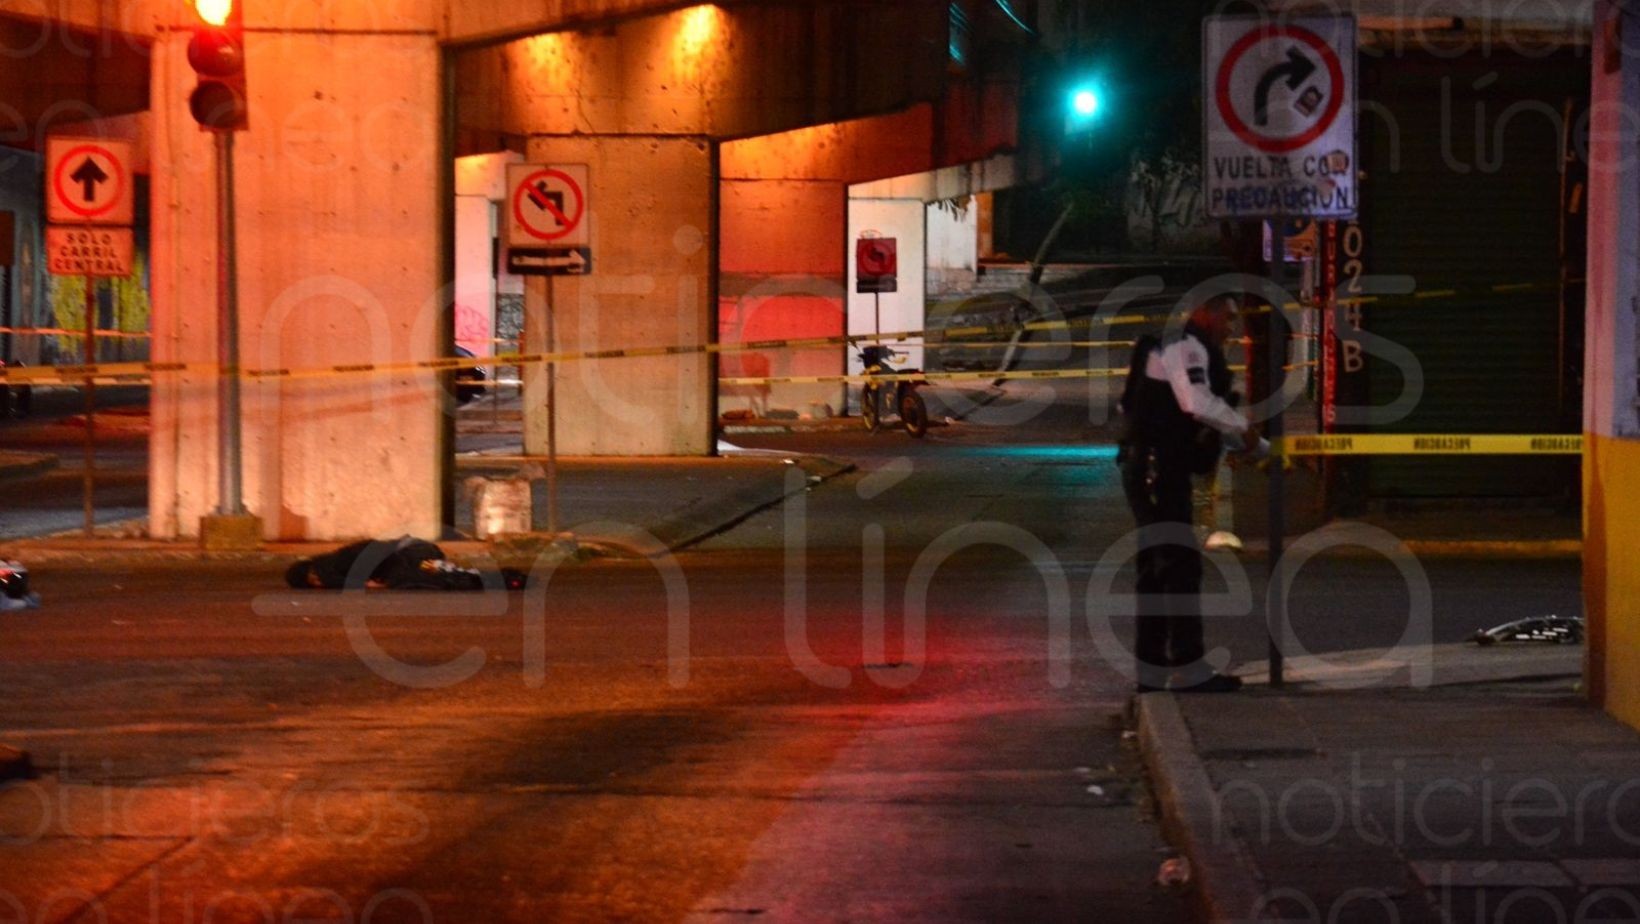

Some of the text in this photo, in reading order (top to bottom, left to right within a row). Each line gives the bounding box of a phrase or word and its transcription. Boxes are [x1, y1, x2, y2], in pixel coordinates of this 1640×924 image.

[1214, 155, 1292, 178] VUELTA
[66, 233, 111, 246] SOLO
[60, 246, 117, 259] CARRIL
[55, 258, 124, 271] CENTRAL
